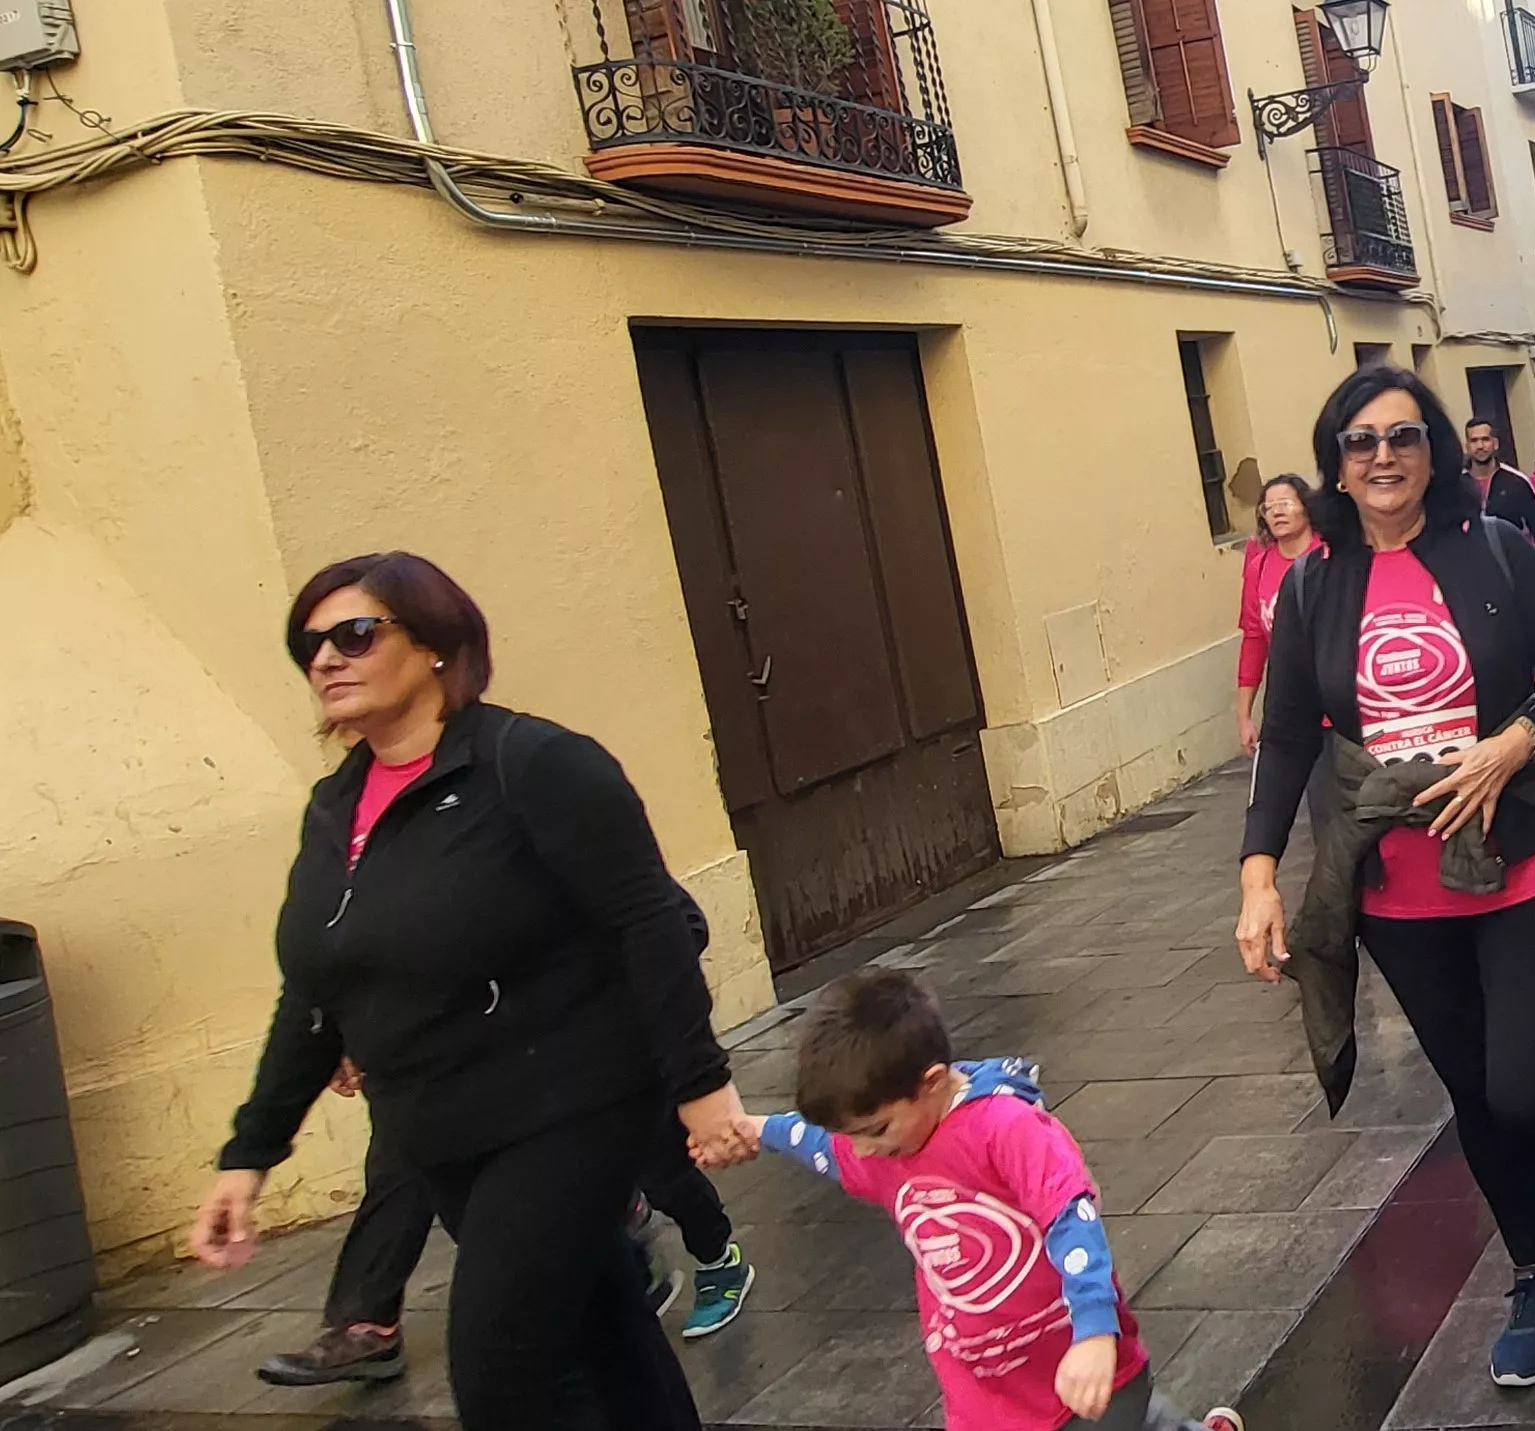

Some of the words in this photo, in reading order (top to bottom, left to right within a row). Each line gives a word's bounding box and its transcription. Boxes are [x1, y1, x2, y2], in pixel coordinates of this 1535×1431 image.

[1368, 739, 1412, 755] CONTRA
[1413, 736, 1427, 746] EL
[1428, 726, 1472, 743] CÁNCER
